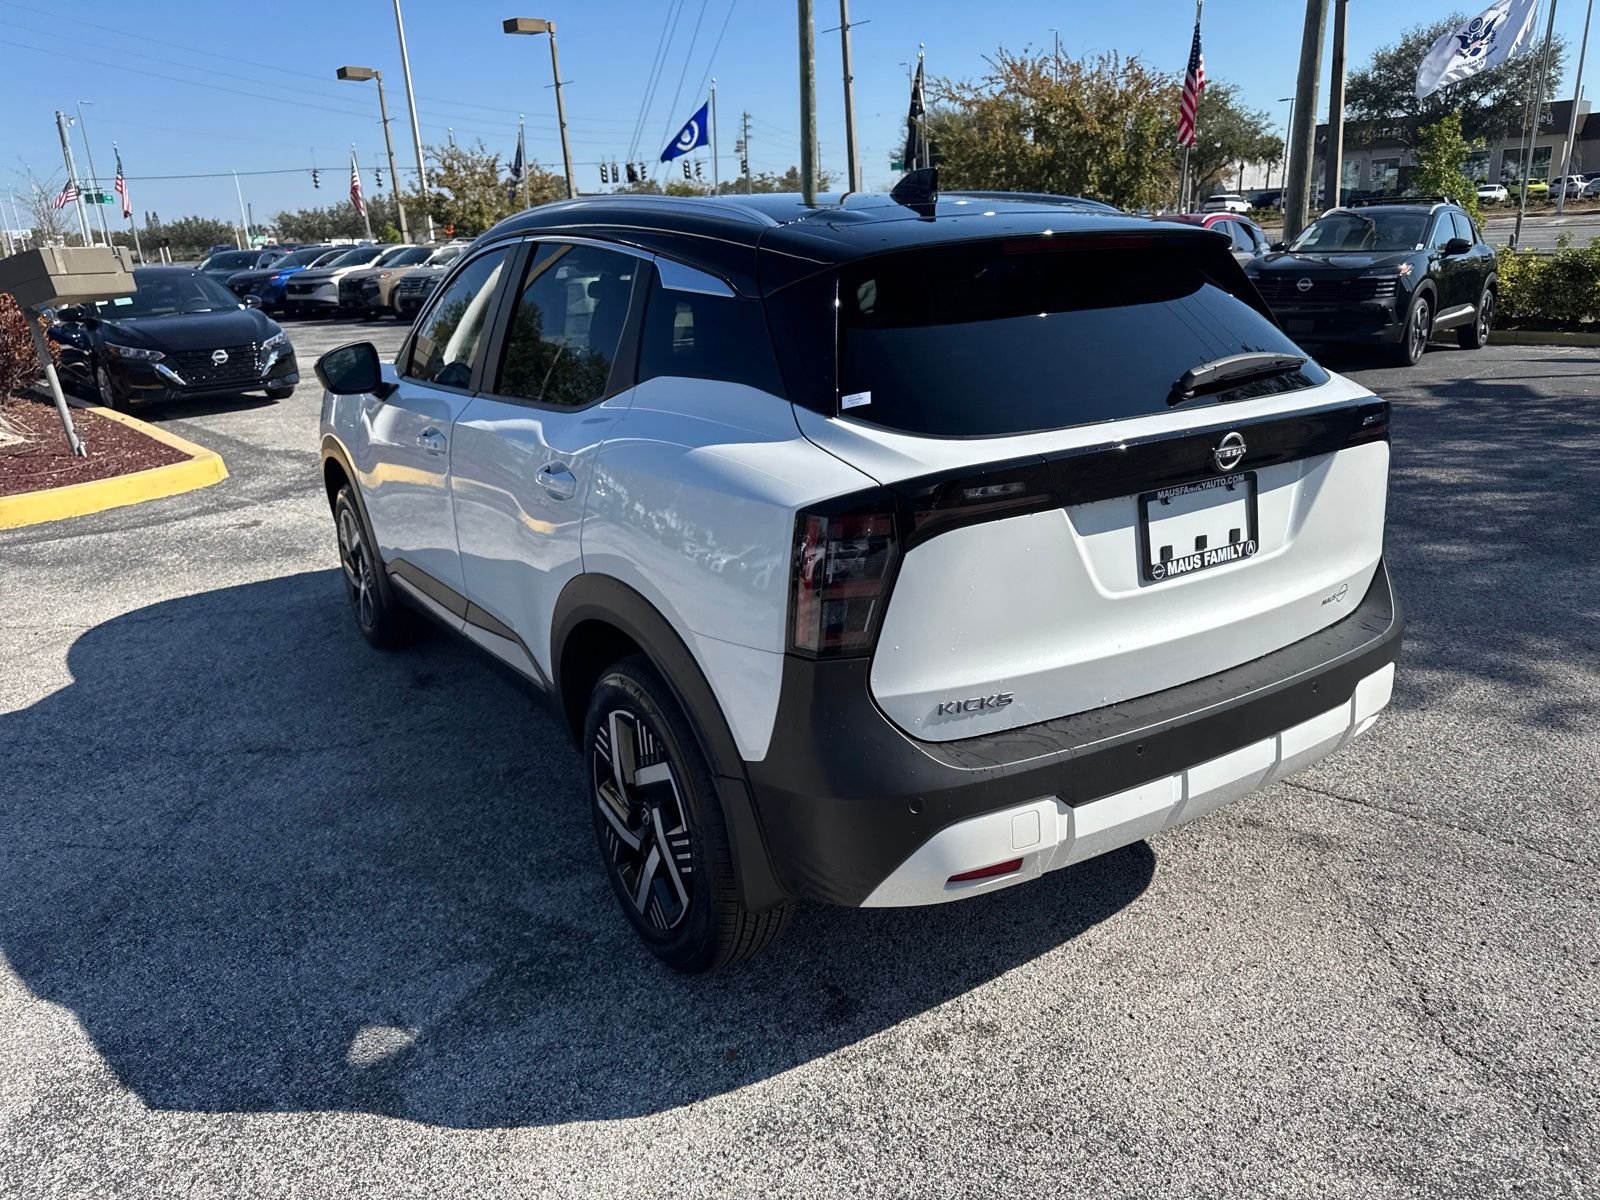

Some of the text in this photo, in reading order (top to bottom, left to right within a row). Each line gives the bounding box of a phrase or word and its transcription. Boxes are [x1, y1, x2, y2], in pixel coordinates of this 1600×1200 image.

[1215, 445, 1247, 459] NISSAN
[1167, 543, 1244, 576] MAUS FAMILY
[938, 691, 1014, 716] KICKS
